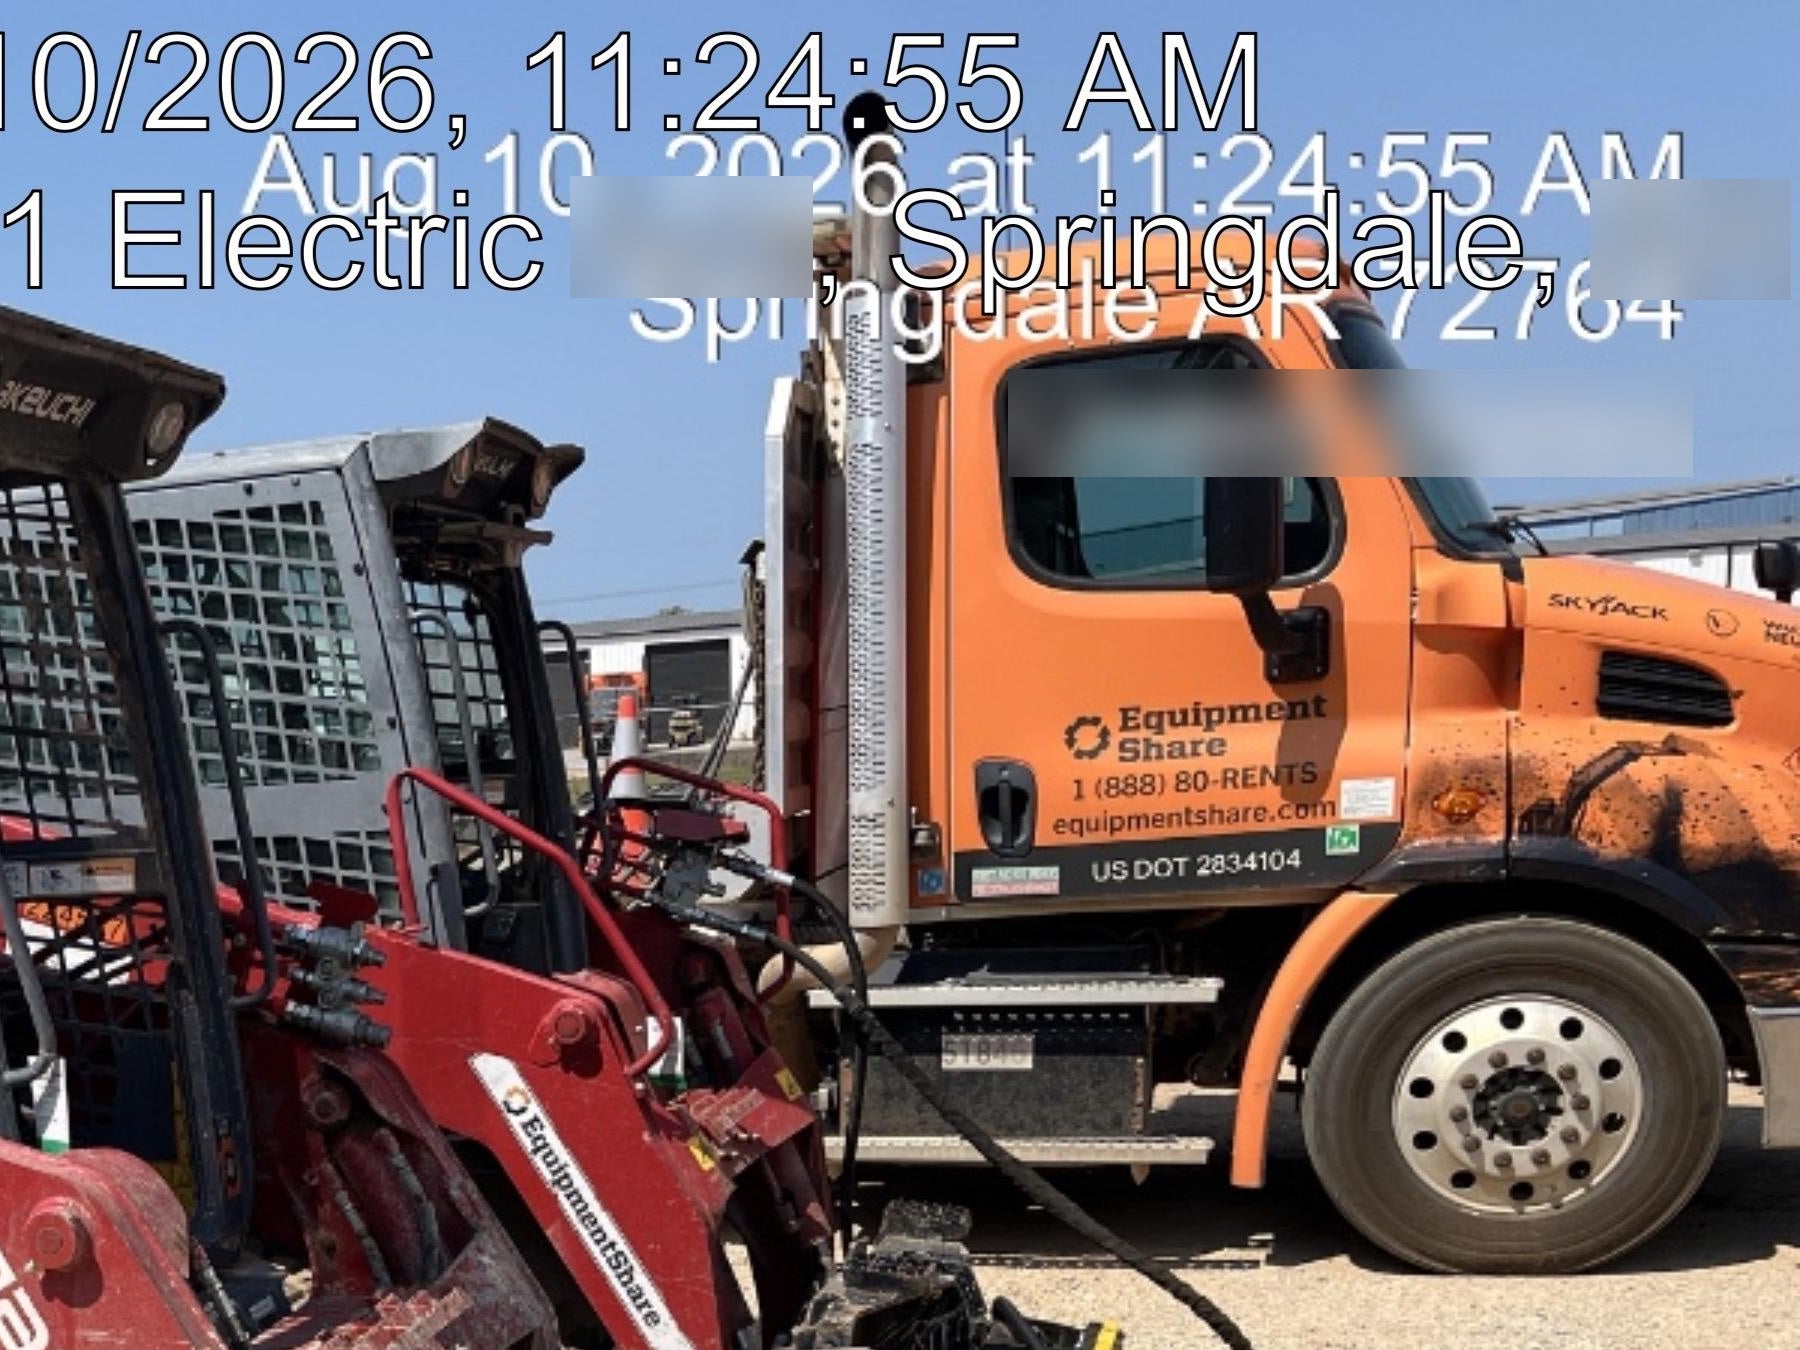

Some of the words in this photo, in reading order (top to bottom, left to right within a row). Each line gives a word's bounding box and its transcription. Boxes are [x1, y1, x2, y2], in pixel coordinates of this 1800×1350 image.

[1547, 592, 1669, 622] SKYJACK
[1118, 694, 1328, 736] Equipment
[1118, 735, 1228, 763] Share
[1073, 778, 1086, 802] 1
[1094, 773, 1166, 801] (888)
[1175, 761, 1319, 793] 80-RENTS
[1053, 799, 1337, 838] equipmentshare.com
[1092, 859, 1129, 883] US
[1133, 855, 1190, 879] DOT
[1196, 848, 1302, 876] 2834104
[520, 1115, 661, 1328] EquipmentShare
